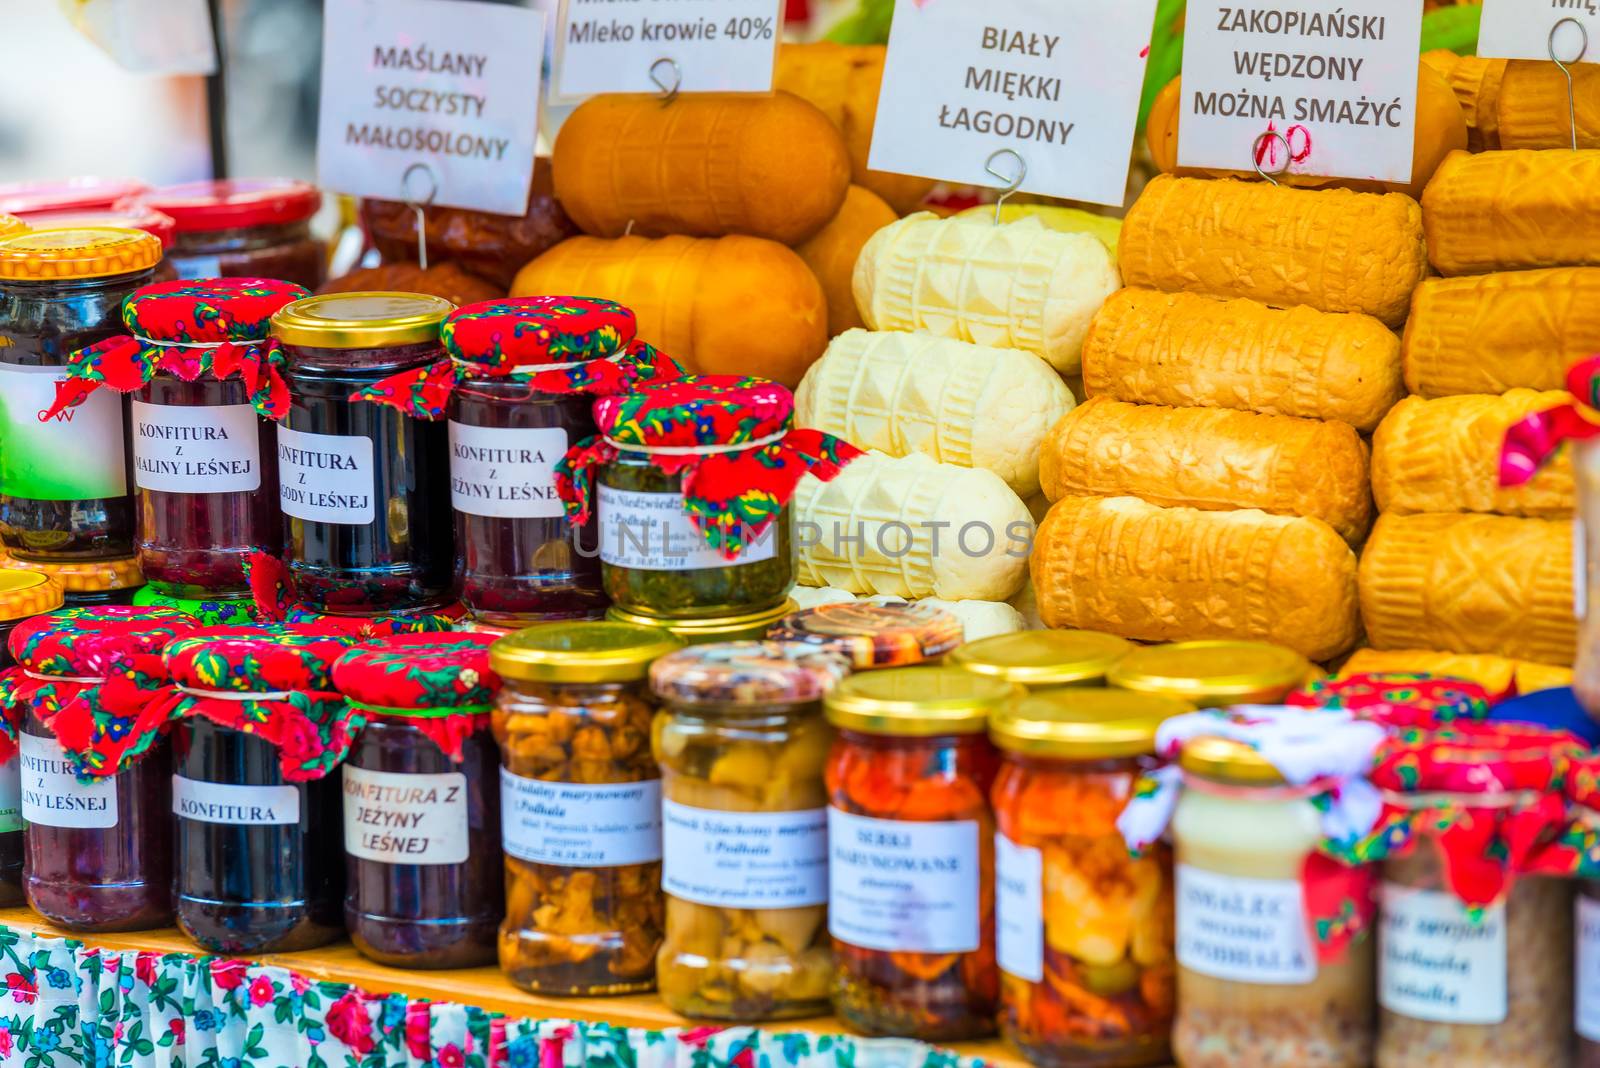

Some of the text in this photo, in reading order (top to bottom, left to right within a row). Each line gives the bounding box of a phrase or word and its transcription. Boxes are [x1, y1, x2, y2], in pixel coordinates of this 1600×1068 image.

[569, 16, 772, 43] Mleko krowie 40%
[1217, 8, 1385, 40] ZAKOPIAŃSKI
[982, 26, 1059, 58] BIAŁY
[373, 43, 487, 77] MAŚLANY
[1234, 51, 1363, 83] WĘDZONY
[965, 67, 1061, 101] MIĘKKI
[373, 85, 485, 118] SOCZYSTY
[1194, 88, 1401, 127] MOŻNA SMAŻYĆ
[939, 105, 1074, 145] ŁAGODNY
[345, 122, 509, 160] MAŁOSOLONY
[139, 422, 229, 440] KONFITURA
[279, 443, 358, 470] ONFITURA
[454, 442, 545, 463] KONFITURA
[186, 458, 251, 476] LEŚNEJ
[309, 491, 368, 509] LEŚNEJ
[453, 478, 560, 500] EŻYNY LEŚNE
[22, 753, 76, 775] ONFITUR
[46, 794, 107, 811] LEŚNEJ
[344, 777, 459, 803] KONFITURA Z
[180, 798, 275, 820] KONFITURA
[356, 806, 425, 828] JEŻYNY
[362, 830, 429, 853] LEŚNEJ
